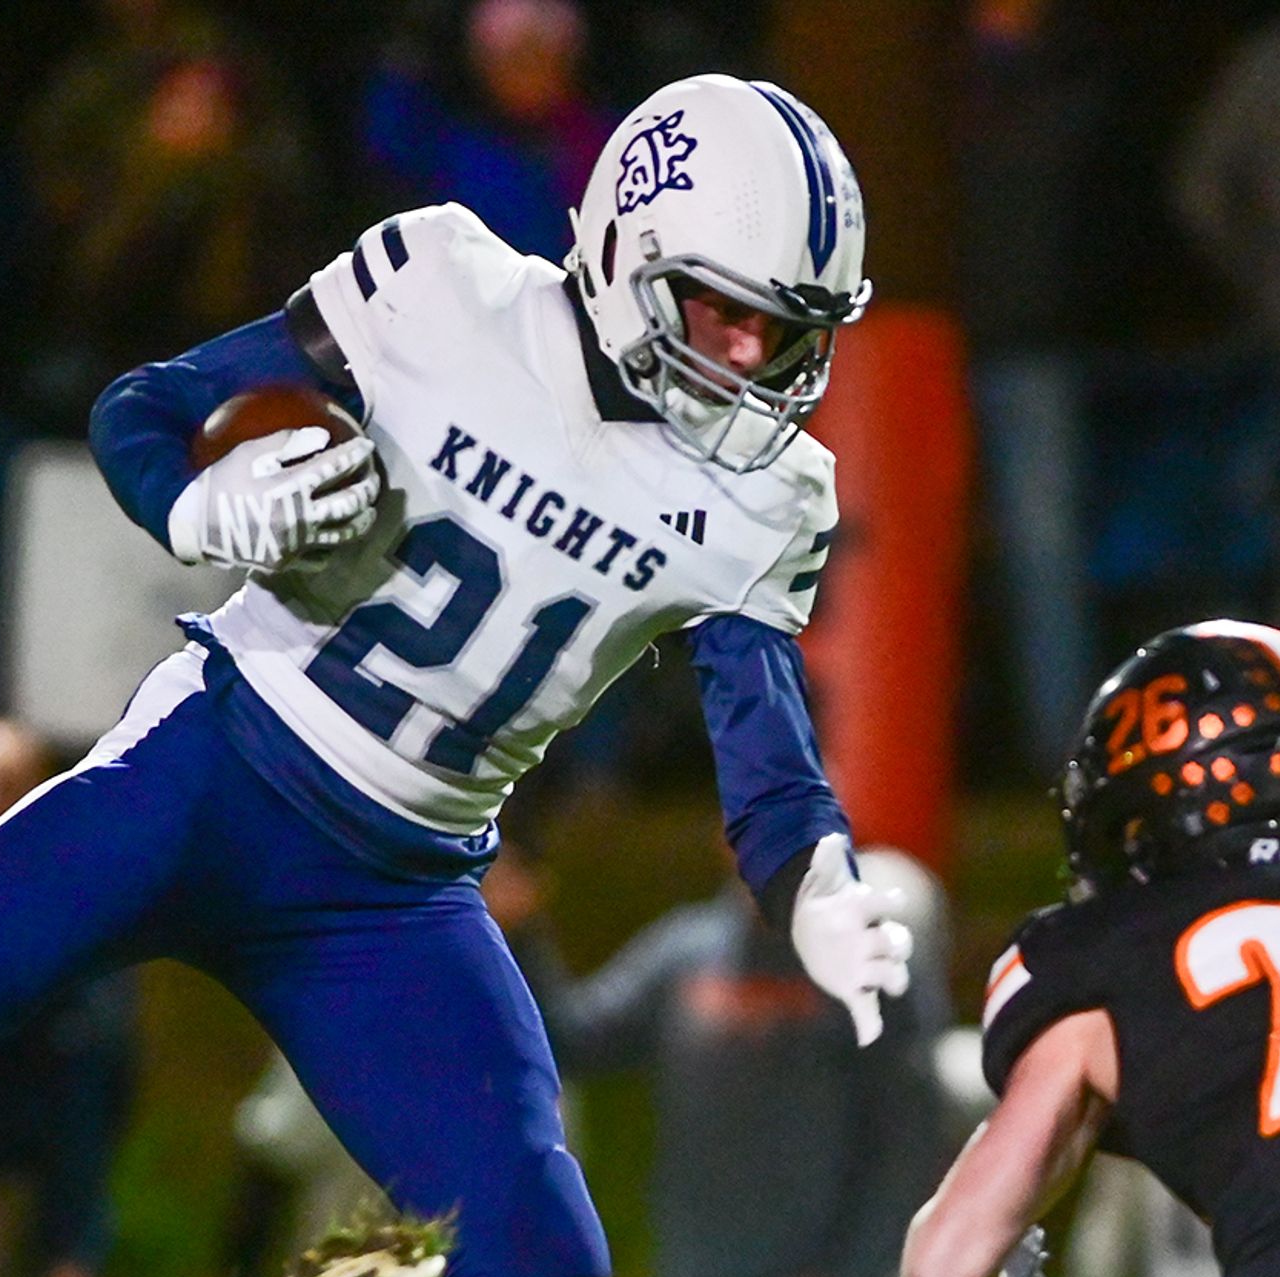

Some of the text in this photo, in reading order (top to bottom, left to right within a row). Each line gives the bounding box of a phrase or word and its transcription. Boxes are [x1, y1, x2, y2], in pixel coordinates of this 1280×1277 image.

[427, 425, 668, 592] KNIGHTS
[306, 513, 600, 774] 21
[1105, 674, 1189, 775] 26
